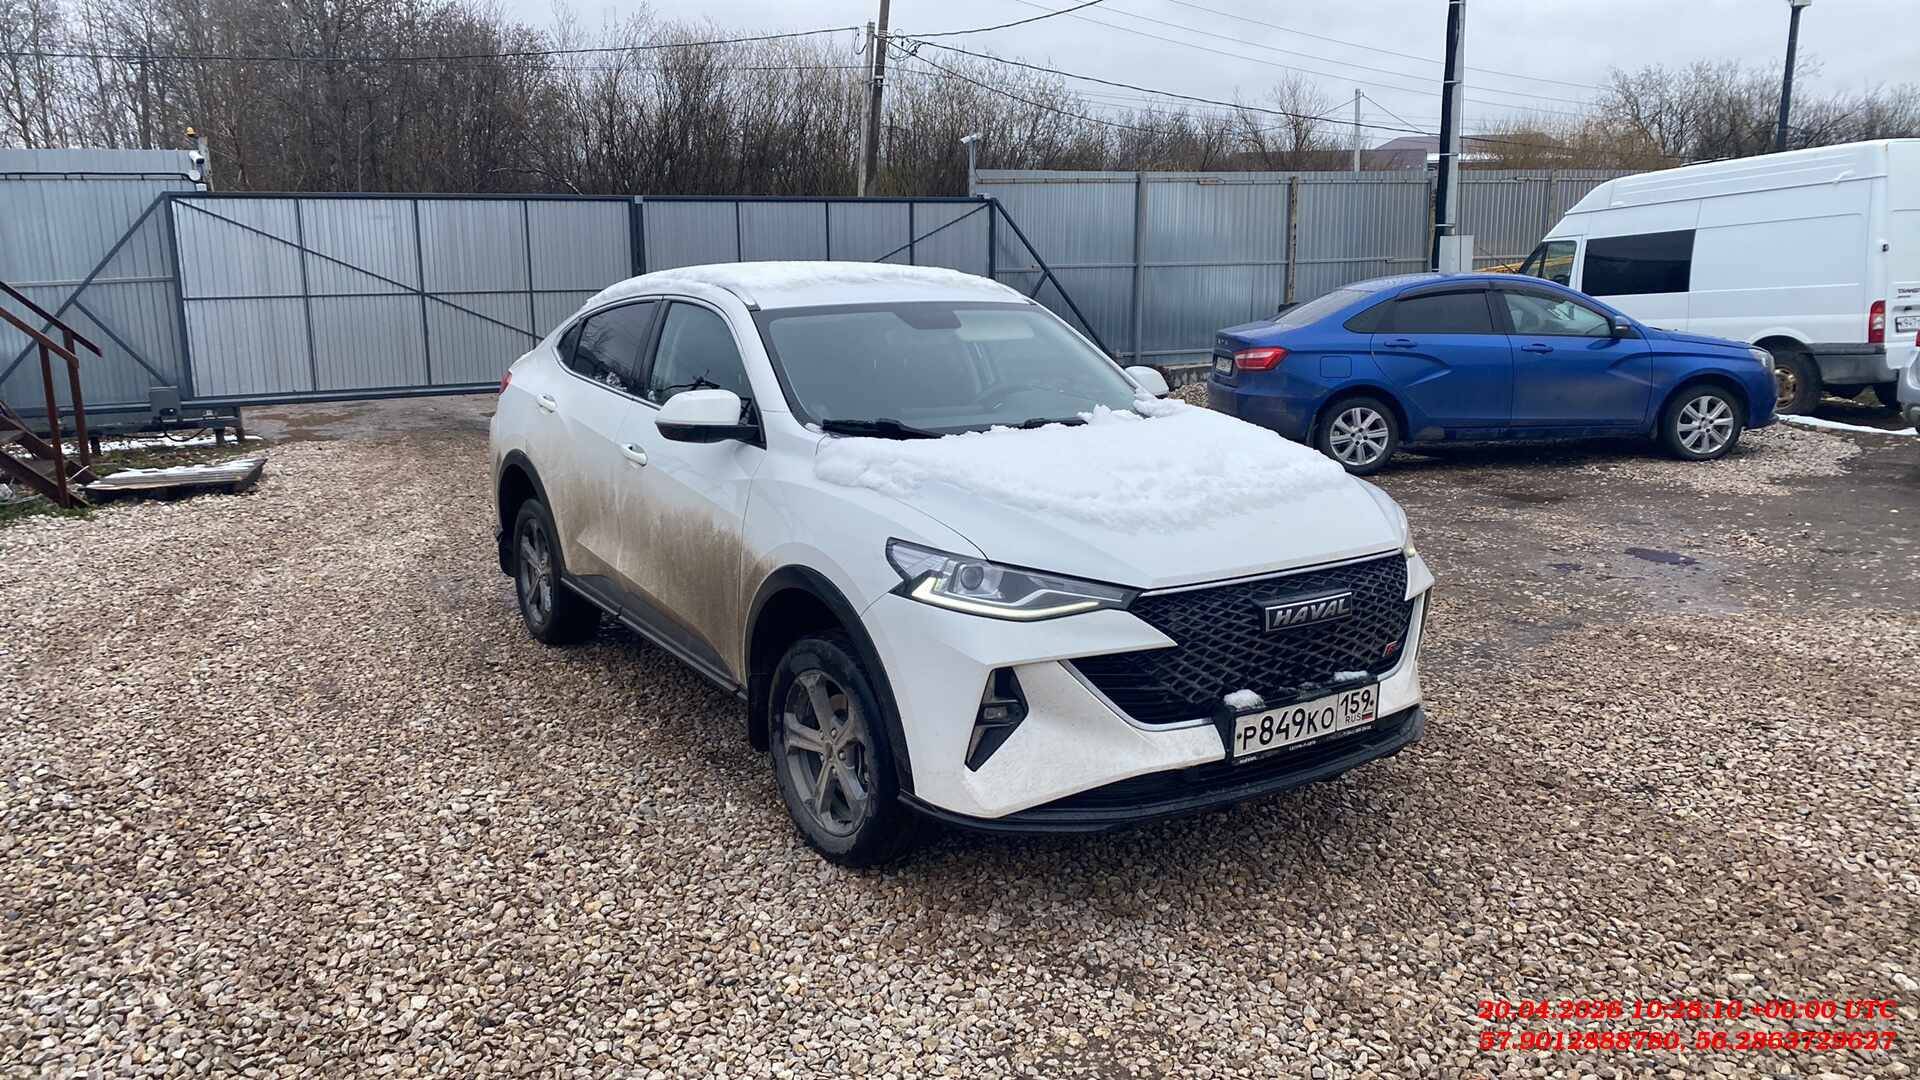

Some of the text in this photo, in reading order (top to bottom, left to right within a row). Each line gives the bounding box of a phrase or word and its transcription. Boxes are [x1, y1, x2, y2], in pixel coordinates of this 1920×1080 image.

[1273, 598, 1350, 627] HAVAL
[1340, 689, 1371, 716] 159
[1345, 713, 1362, 723] RUS
